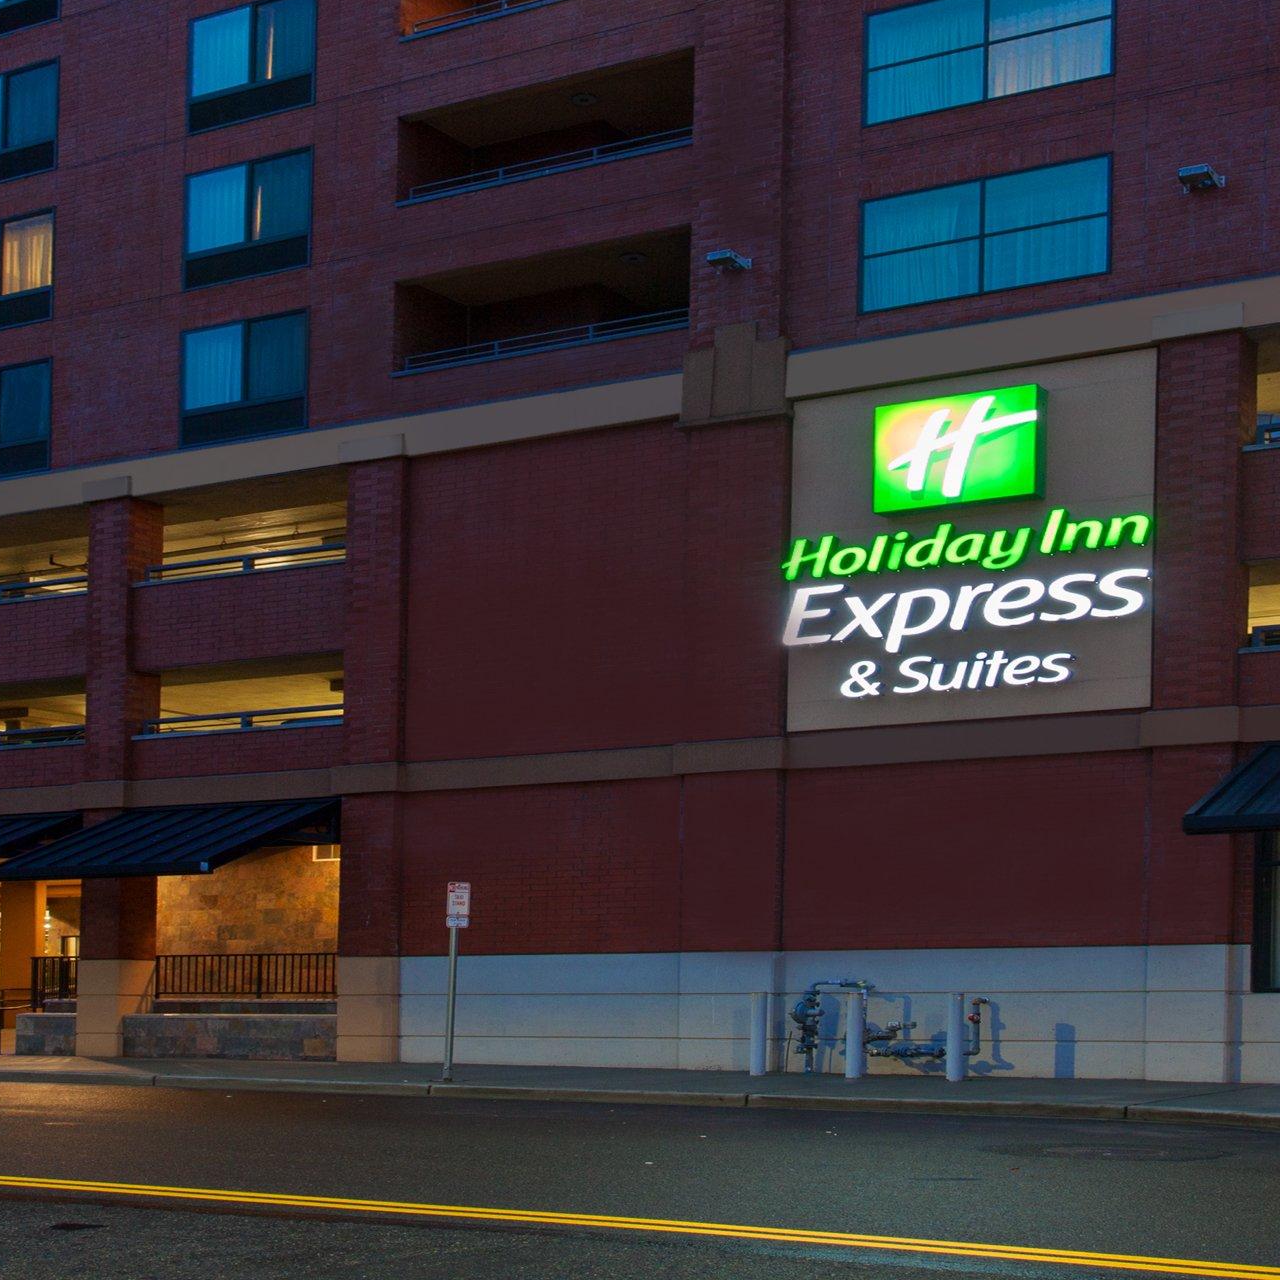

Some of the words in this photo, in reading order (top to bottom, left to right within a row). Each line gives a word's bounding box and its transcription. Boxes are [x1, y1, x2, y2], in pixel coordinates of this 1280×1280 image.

[781, 522, 1033, 581] Holiday
[1039, 507, 1152, 555] Inn
[782, 567, 1150, 653] Express
[839, 659, 881, 699] &
[892, 649, 1072, 694] Suites
